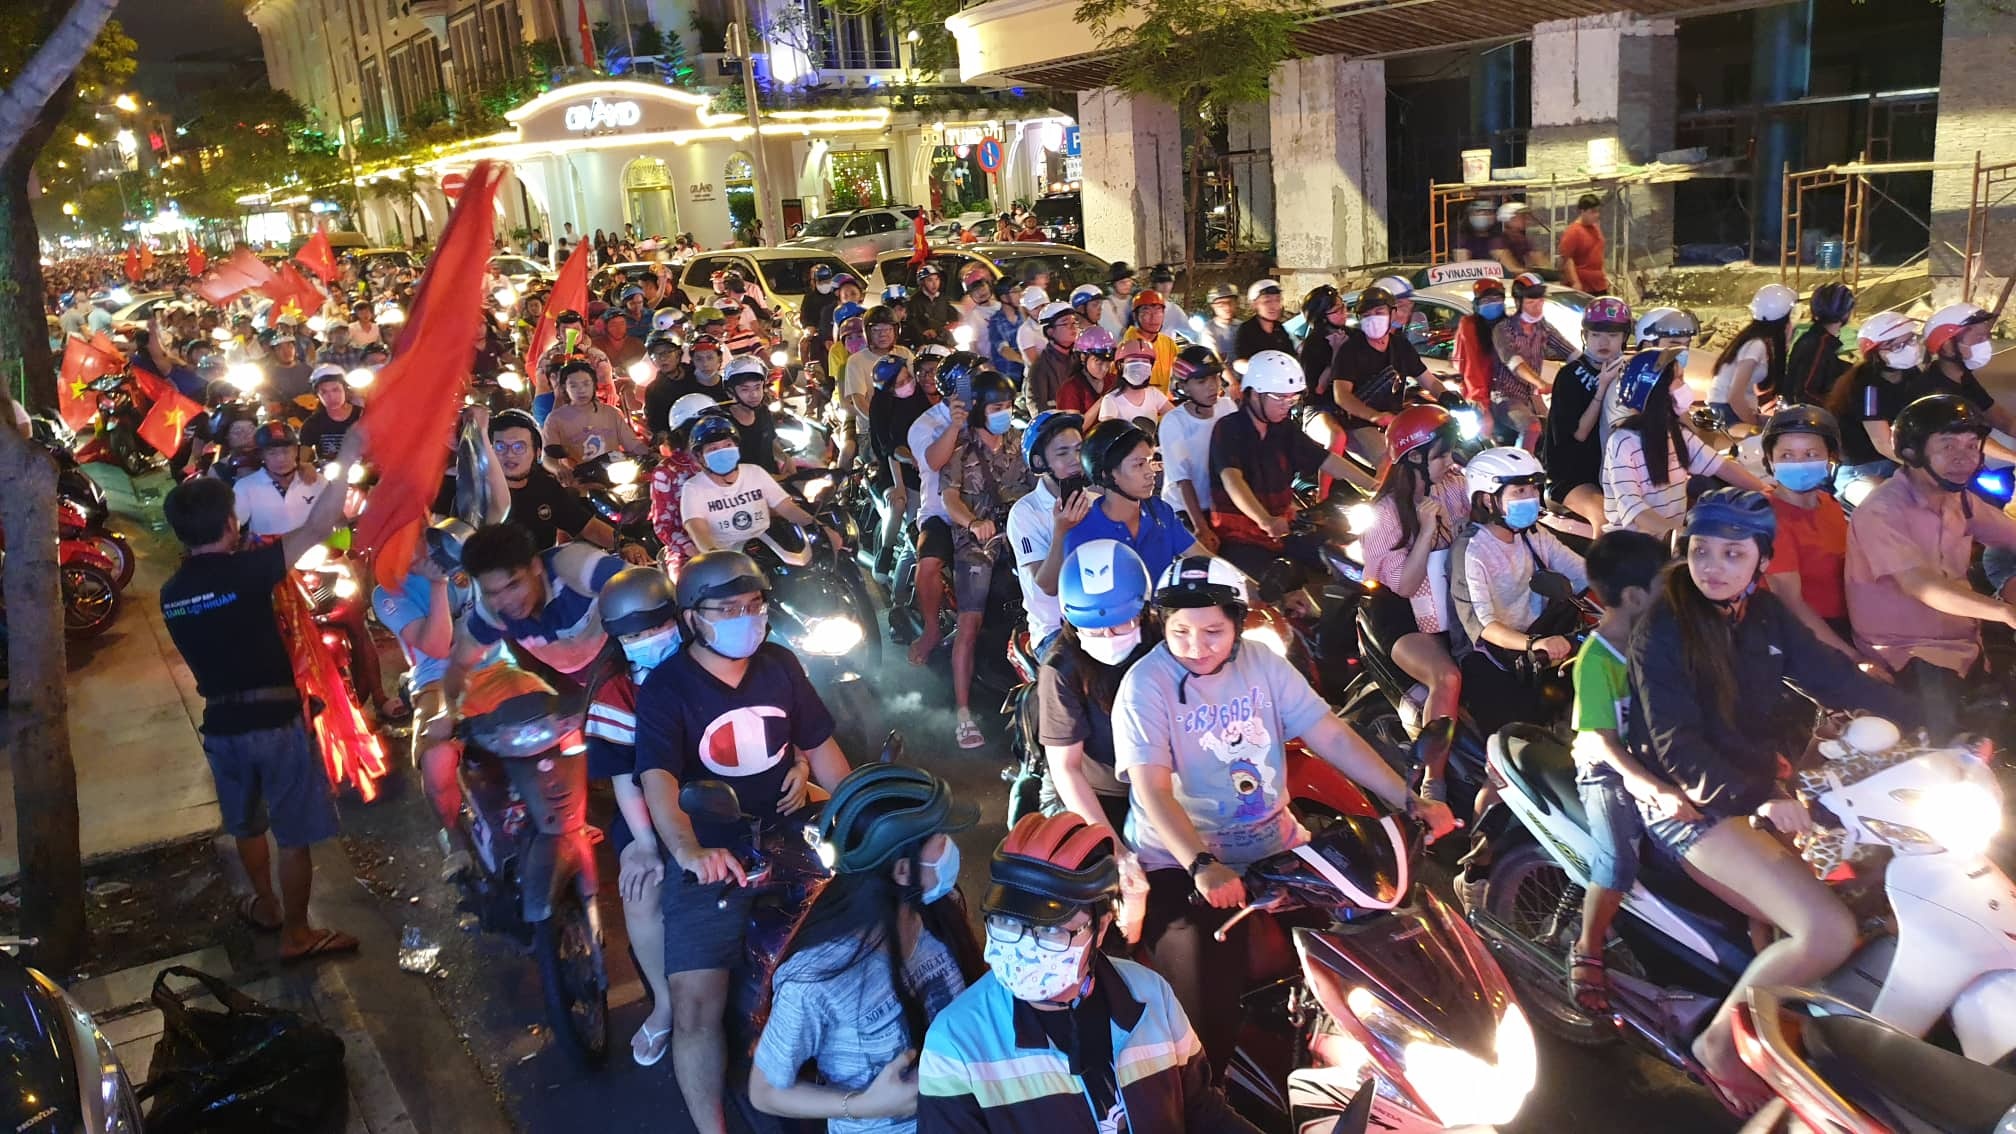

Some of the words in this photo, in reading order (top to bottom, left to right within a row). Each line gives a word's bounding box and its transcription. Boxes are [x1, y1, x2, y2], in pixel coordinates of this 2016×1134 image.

[1445, 267, 1483, 279] VINASUN
[1483, 265, 1502, 277] TAXI
[707, 489, 764, 512] HOLLISTER
[718, 520, 730, 529] 19
